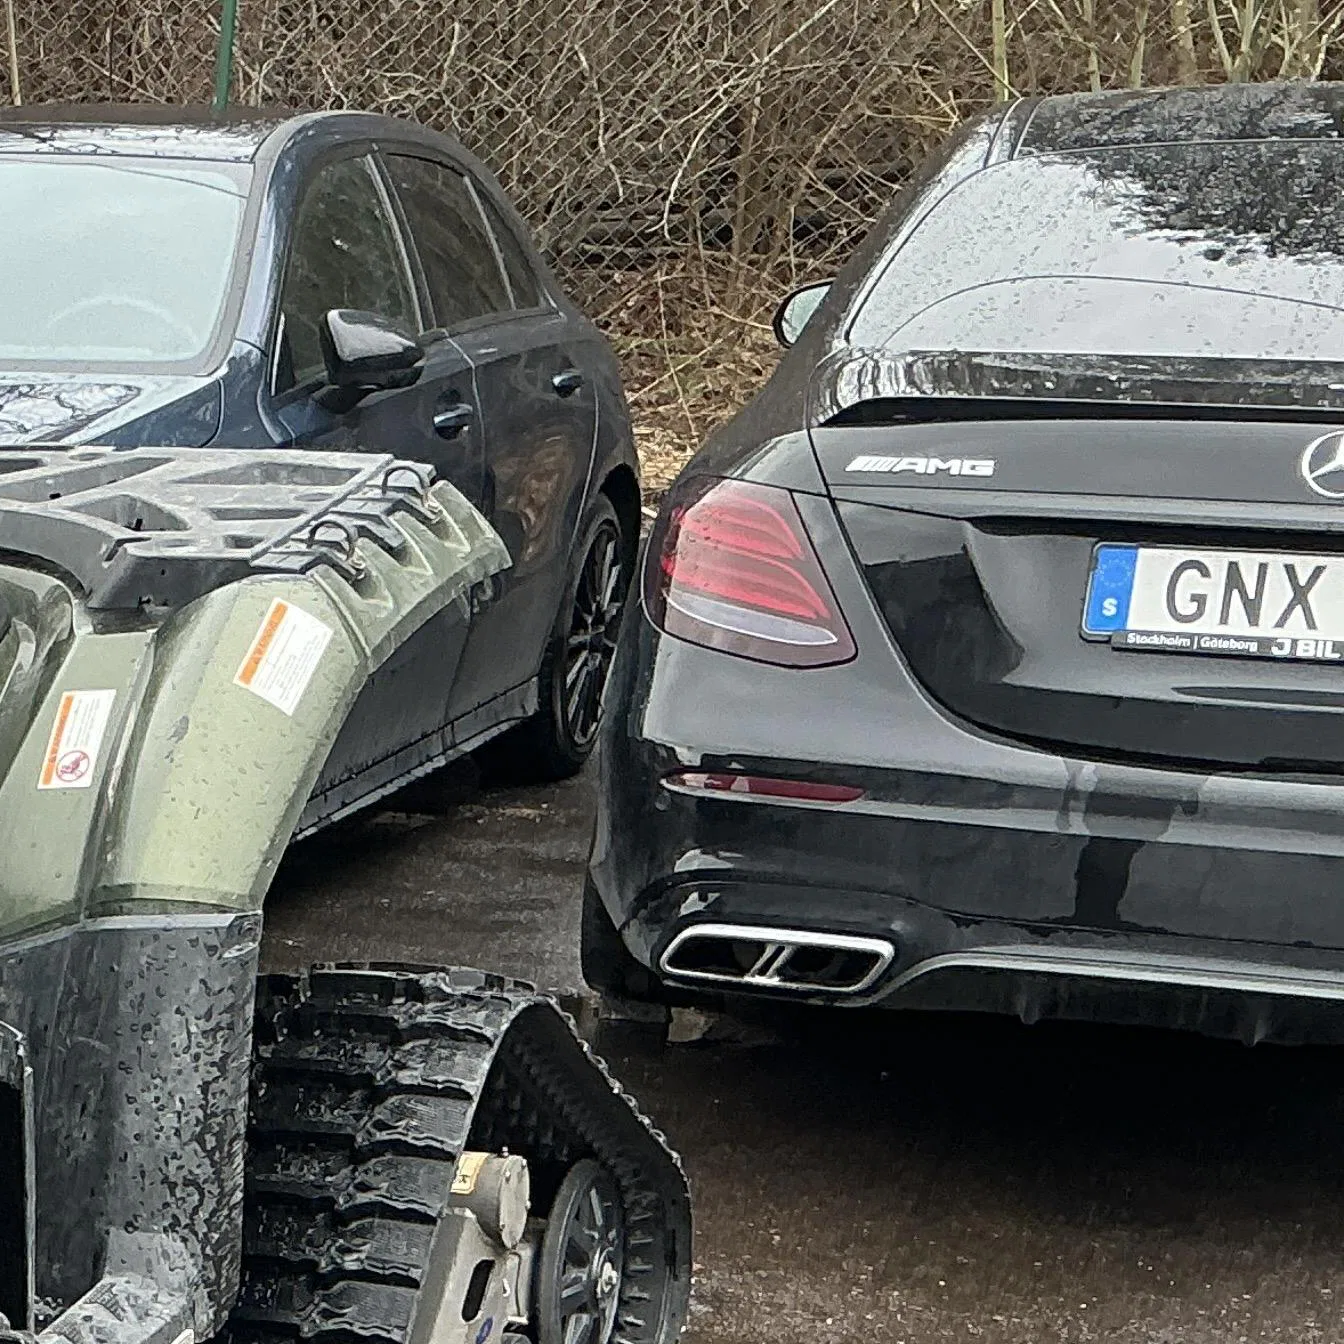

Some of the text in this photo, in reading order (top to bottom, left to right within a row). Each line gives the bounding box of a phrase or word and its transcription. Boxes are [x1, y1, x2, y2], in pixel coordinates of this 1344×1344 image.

[891, 456, 995, 477] AMG
[1166, 559, 1327, 630] GNX
[1102, 597, 1117, 616] S
[1126, 632, 1191, 648] Stockholm
[1200, 635, 1259, 652] Göteborg
